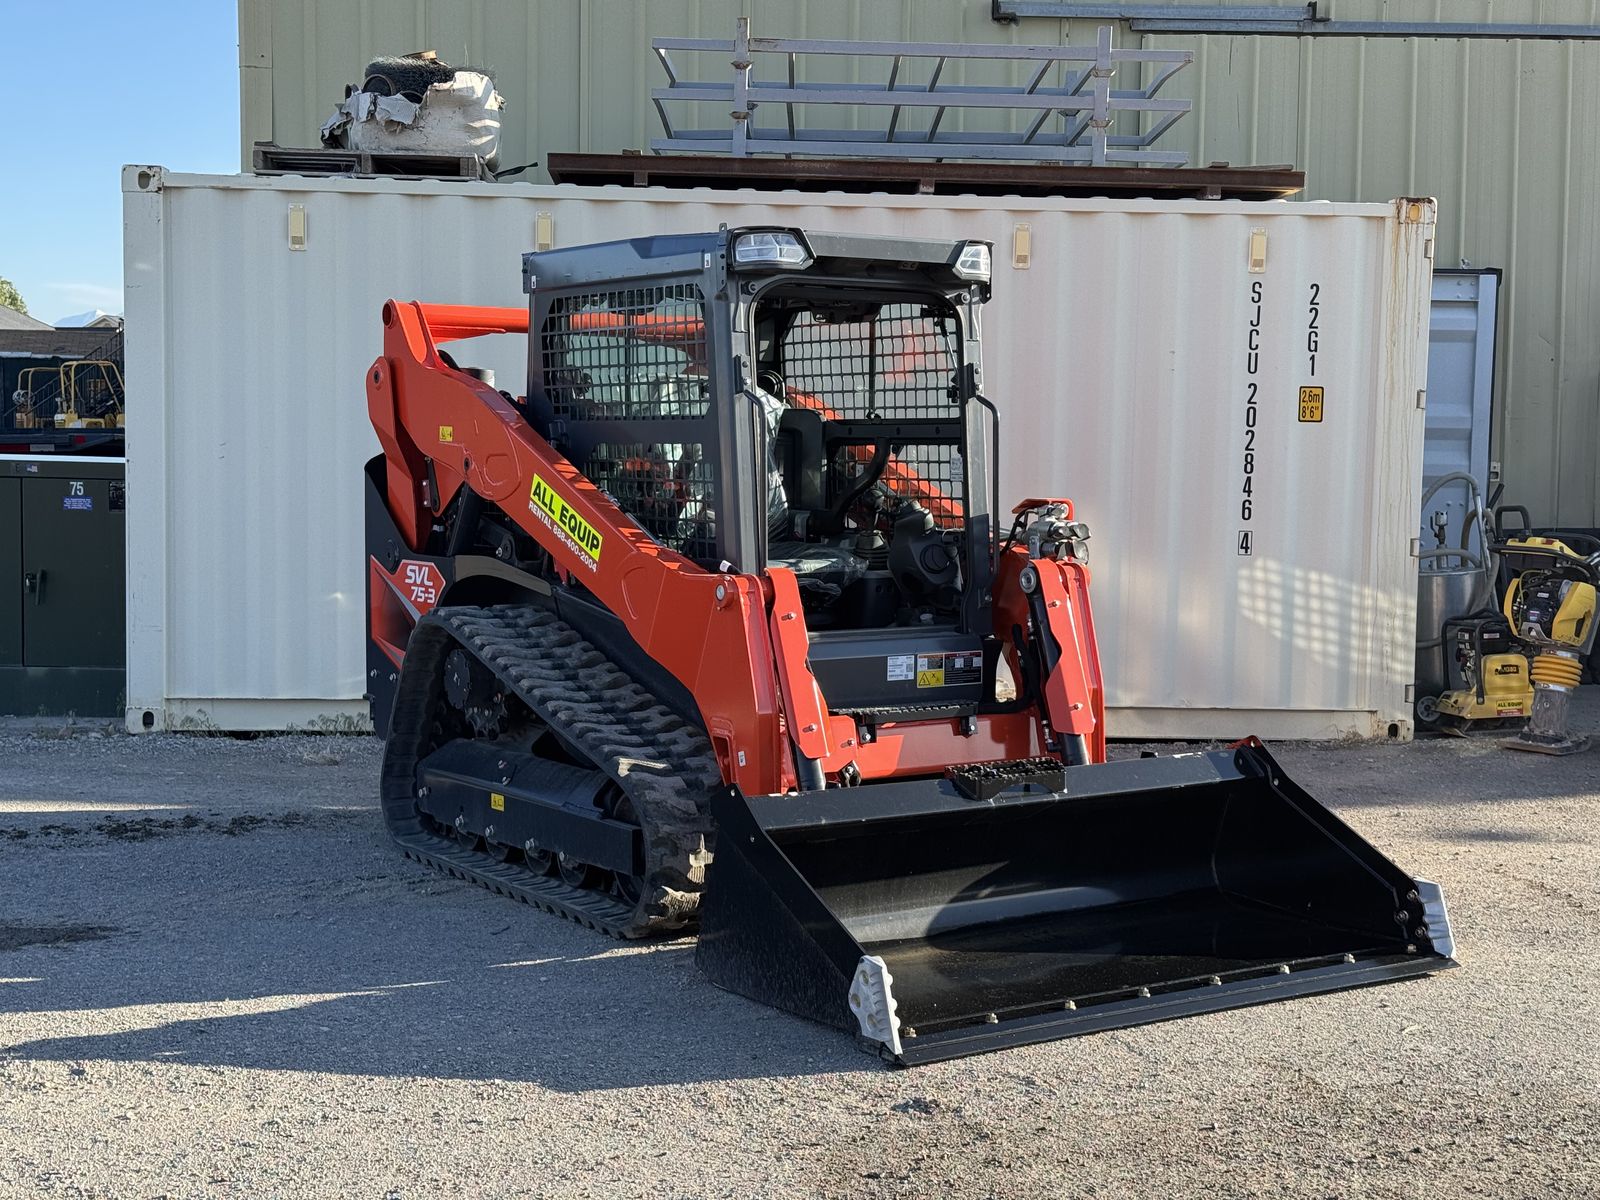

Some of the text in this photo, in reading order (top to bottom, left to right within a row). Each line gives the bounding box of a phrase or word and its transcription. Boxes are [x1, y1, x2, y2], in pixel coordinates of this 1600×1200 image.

[1307, 283, 1320, 376] 22G1
[1239, 281, 1262, 554] SJCU 202846 4
[1301, 390, 1320, 405] 2,6m
[69, 481, 84, 496] 75
[528, 500, 597, 573] RENTAL 888-400-2004
[532, 481, 600, 552] ALL EQUIP
[405, 565, 433, 586] SVL
[411, 586, 436, 604] 75-3
